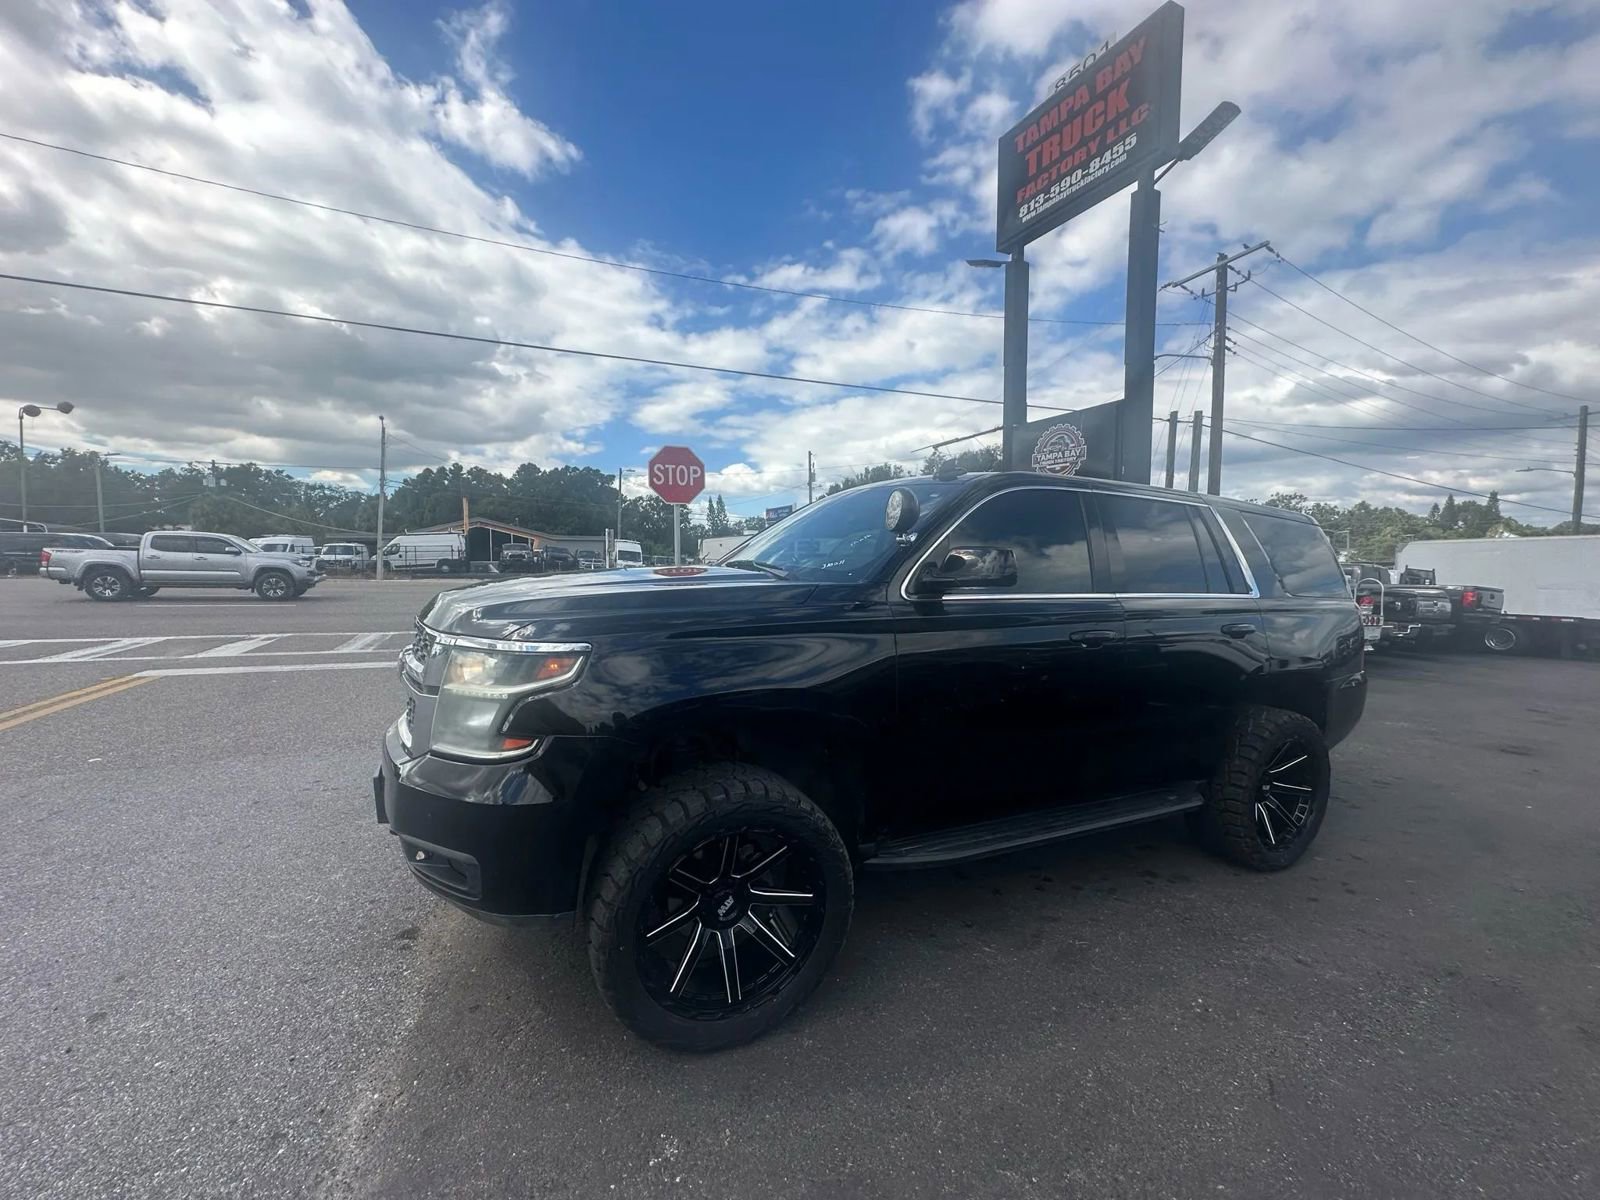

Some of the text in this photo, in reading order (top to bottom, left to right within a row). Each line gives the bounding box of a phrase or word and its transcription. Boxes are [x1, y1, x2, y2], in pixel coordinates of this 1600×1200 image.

[1014, 35, 1149, 153] TAMPA BAY
[1025, 79, 1131, 177] TRUCK
[1016, 103, 1149, 204] FACTORY LLC
[1019, 132, 1137, 218] 813-590-8455
[652, 464, 701, 486] STOP
[1036, 451, 1063, 462] TAMPA
[1064, 448, 1081, 458] BAY
